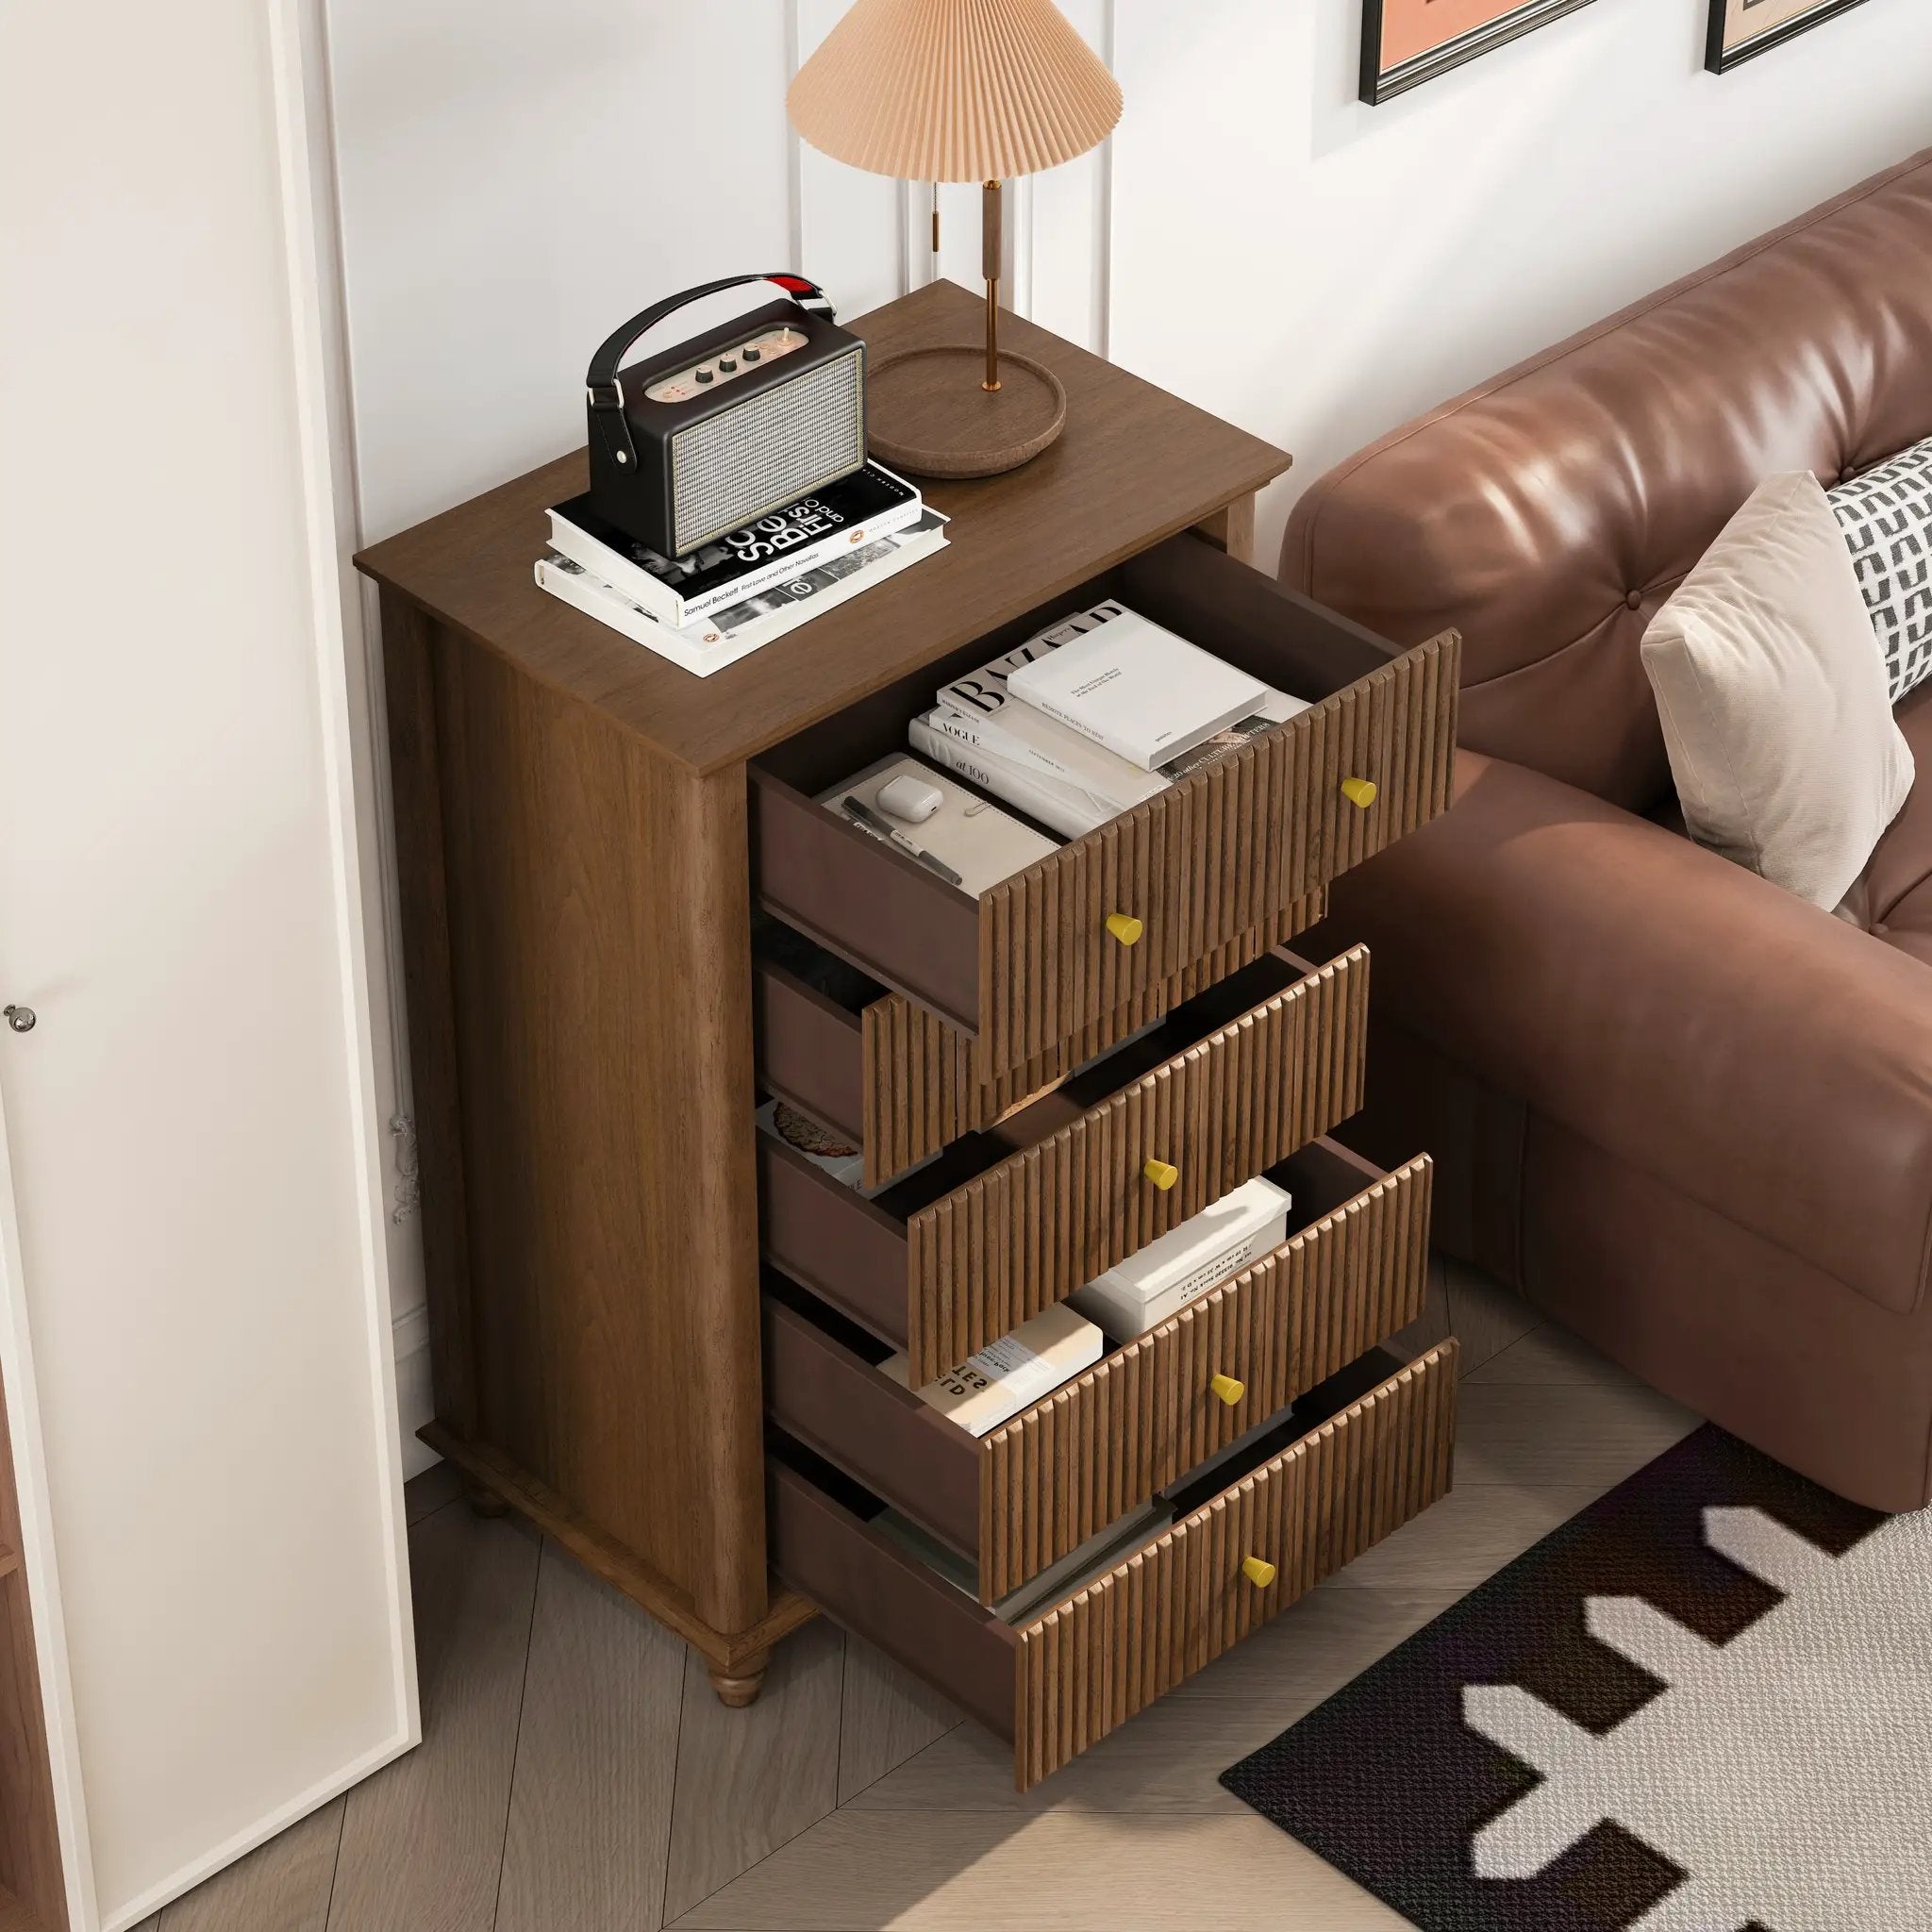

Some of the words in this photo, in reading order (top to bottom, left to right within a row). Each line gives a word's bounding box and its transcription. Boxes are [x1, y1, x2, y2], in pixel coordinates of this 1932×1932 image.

[814, 505, 844, 523] and
[684, 598, 711, 617] Samuel
[712, 587, 740, 605] Beckett
[741, 582, 753, 591] First
[753, 576, 766, 587] Love
[766, 571, 779, 580] and
[779, 563, 795, 575] Other
[795, 552, 820, 567] Novellas
[942, 723, 980, 746] VOGUE
[956, 760, 966, 772] at
[969, 765, 990, 785] 100
